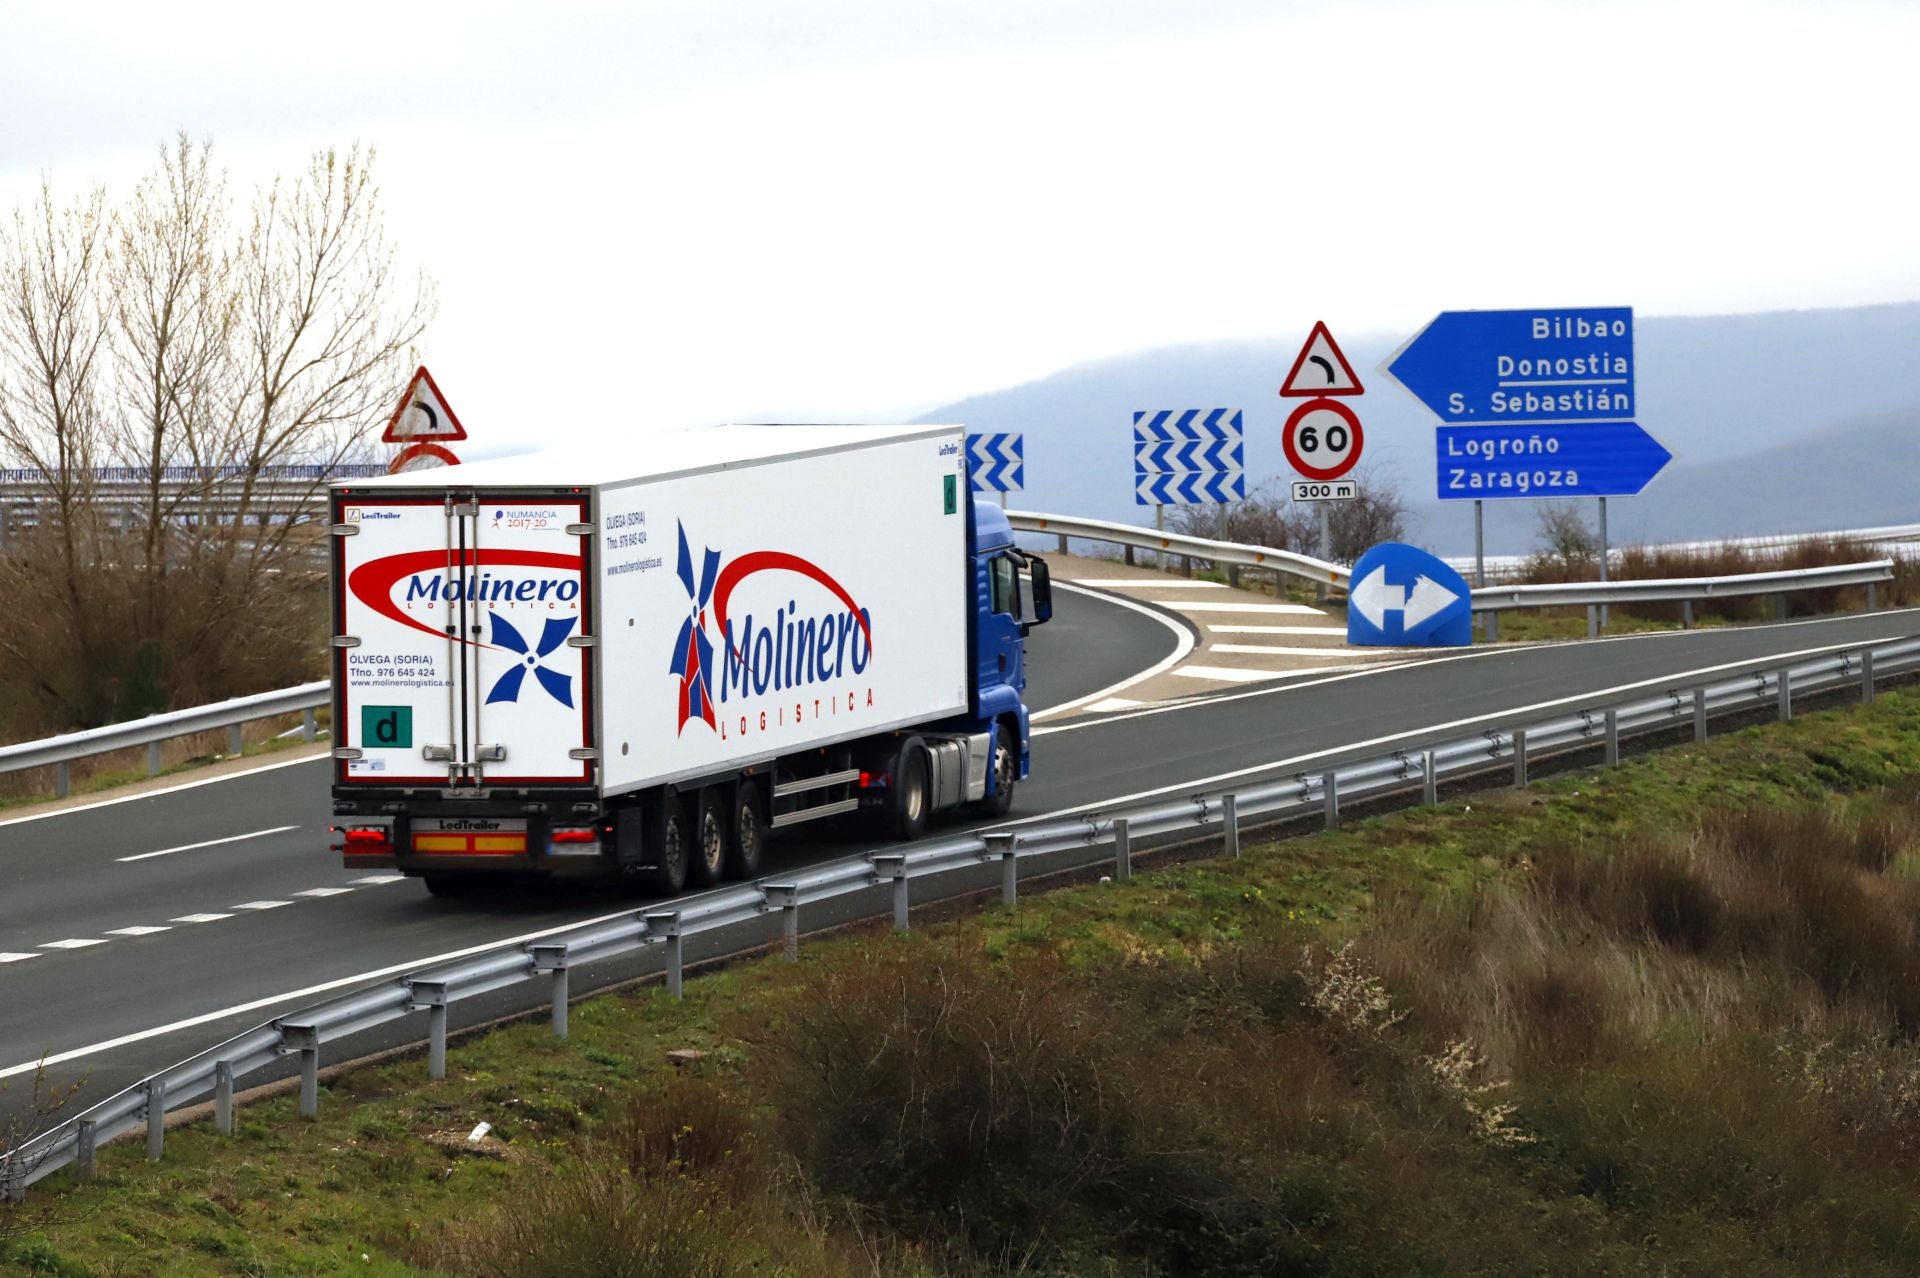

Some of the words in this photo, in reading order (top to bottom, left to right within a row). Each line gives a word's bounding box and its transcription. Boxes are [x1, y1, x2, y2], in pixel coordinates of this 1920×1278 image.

[1532, 316, 1626, 339] Bilbao
[1497, 352, 1628, 376] Donostia
[1448, 392, 1475, 414] S.
[1491, 388, 1629, 413] Sebastián
[1299, 425, 1348, 453] 60
[1447, 435, 1559, 460] Logroño
[1298, 485, 1331, 498] 300
[1337, 486, 1351, 497] m
[1449, 468, 1578, 493] Zaragoza
[506, 510, 557, 519] NUMANCIA
[507, 519, 547, 530] 2017-20
[406, 573, 579, 601] Molinero
[349, 653, 391, 664] ÓLVEGA
[393, 655, 433, 665] (SORIA)
[721, 599, 872, 703] Molinero
[350, 668, 375, 677] Tfno.
[377, 668, 395, 677] 976
[397, 668, 415, 677] 645
[417, 668, 435, 677] 424
[351, 679, 455, 688] www.molinerologistica.es
[721, 688, 873, 740] LOGISTICA
[376, 711, 398, 743] d
[440, 819, 500, 830] LeciTrailer
